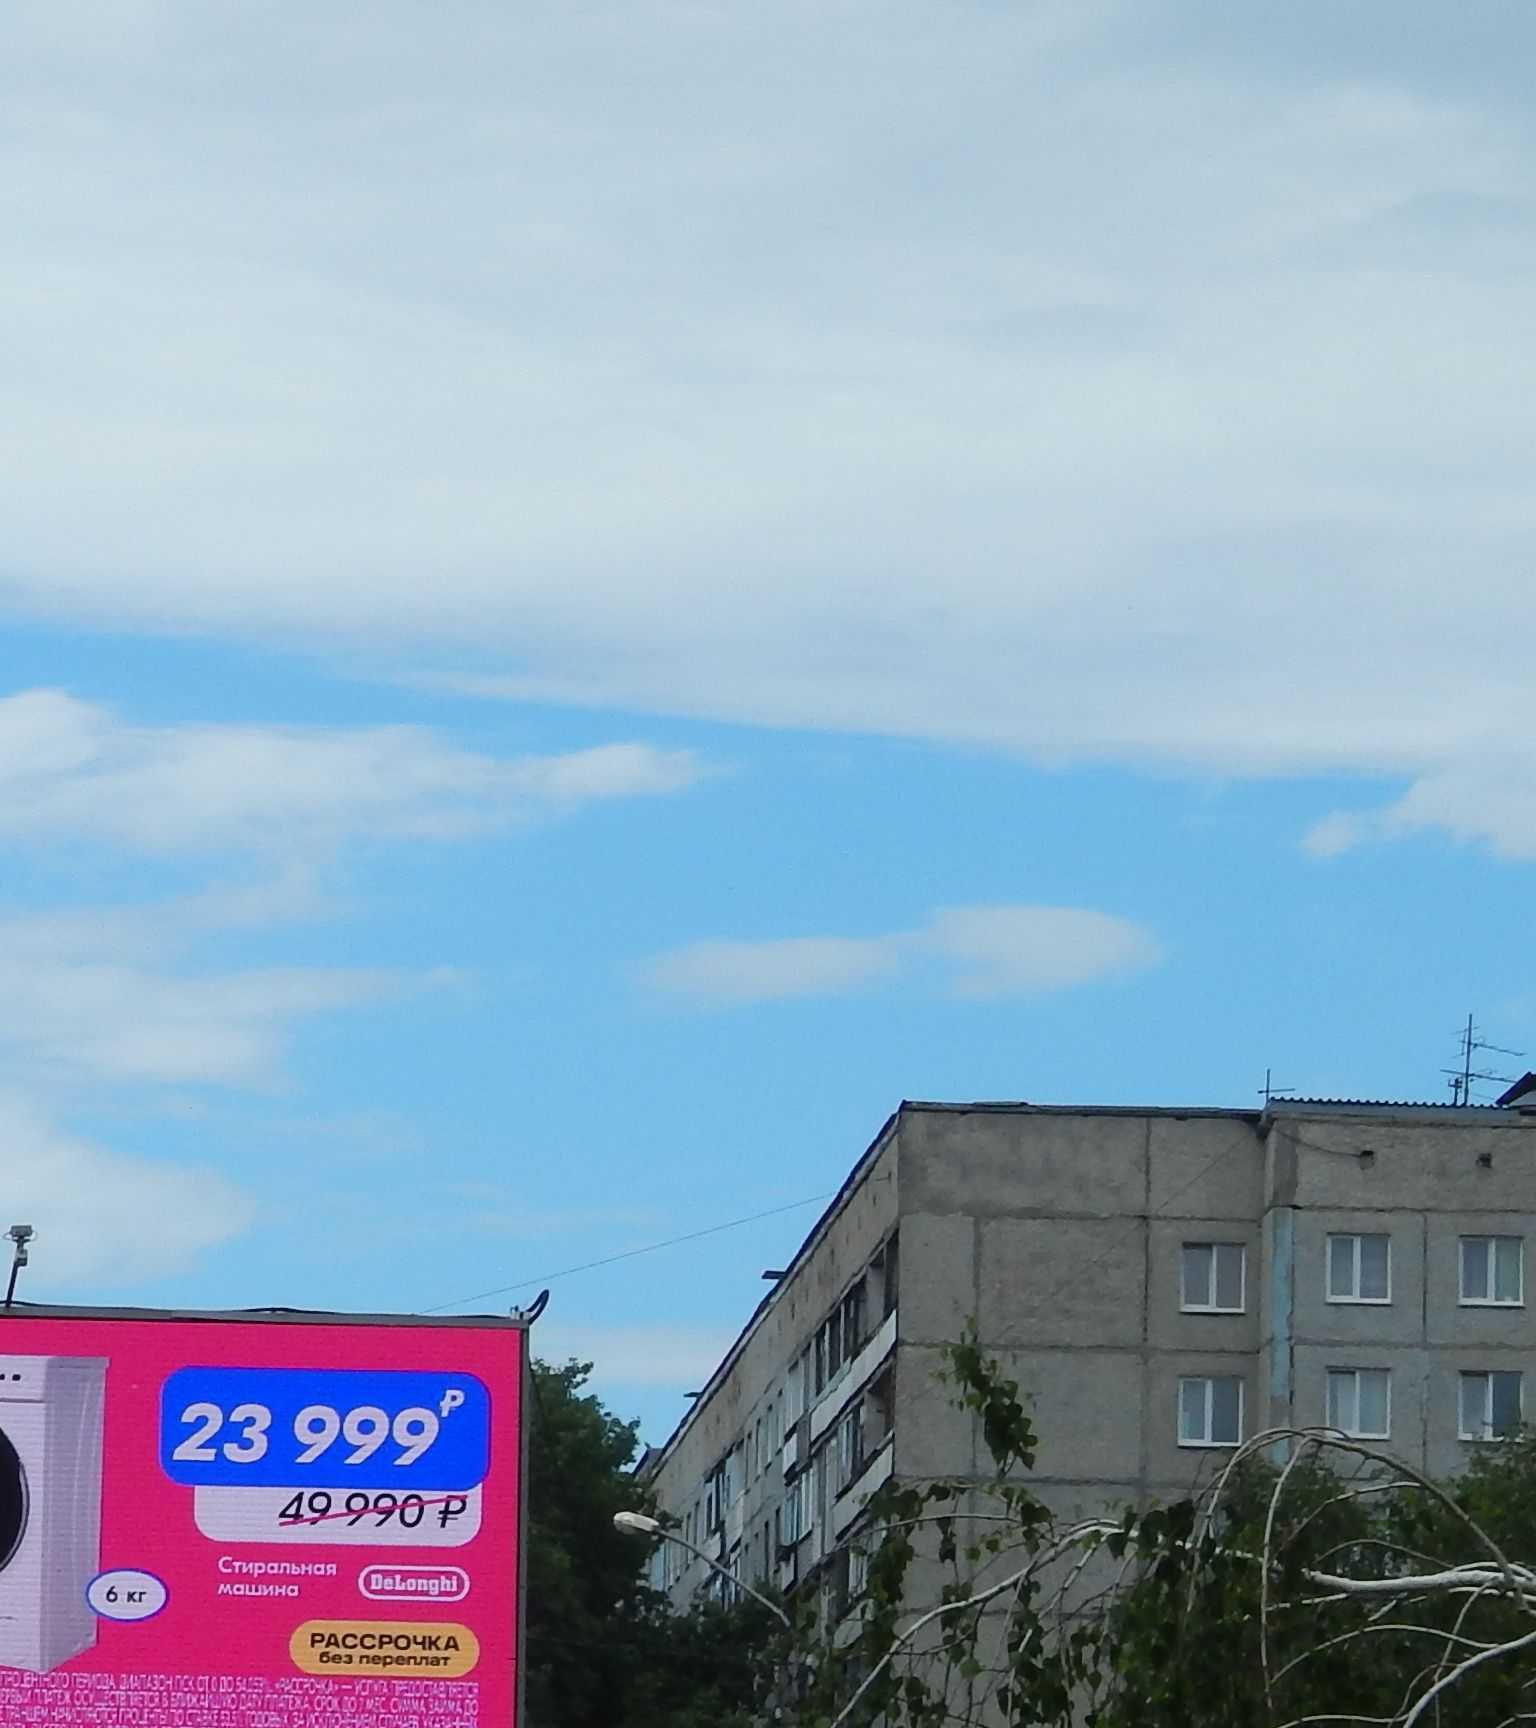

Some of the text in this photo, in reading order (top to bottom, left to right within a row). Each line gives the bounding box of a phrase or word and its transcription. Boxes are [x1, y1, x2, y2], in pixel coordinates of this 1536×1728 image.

[172, 1402, 272, 1464] 23
[278, 1491, 332, 1526] 49
[344, 1493, 425, 1528] 990
[217, 1556, 337, 1577] Стиральная
[217, 1580, 300, 1599] машина
[370, 1573, 459, 1594] DeLonghi
[105, 1585, 147, 1604] 6 кг
[309, 1631, 461, 1652] РАССРОЧКА
[318, 1650, 451, 1670] без переплат
